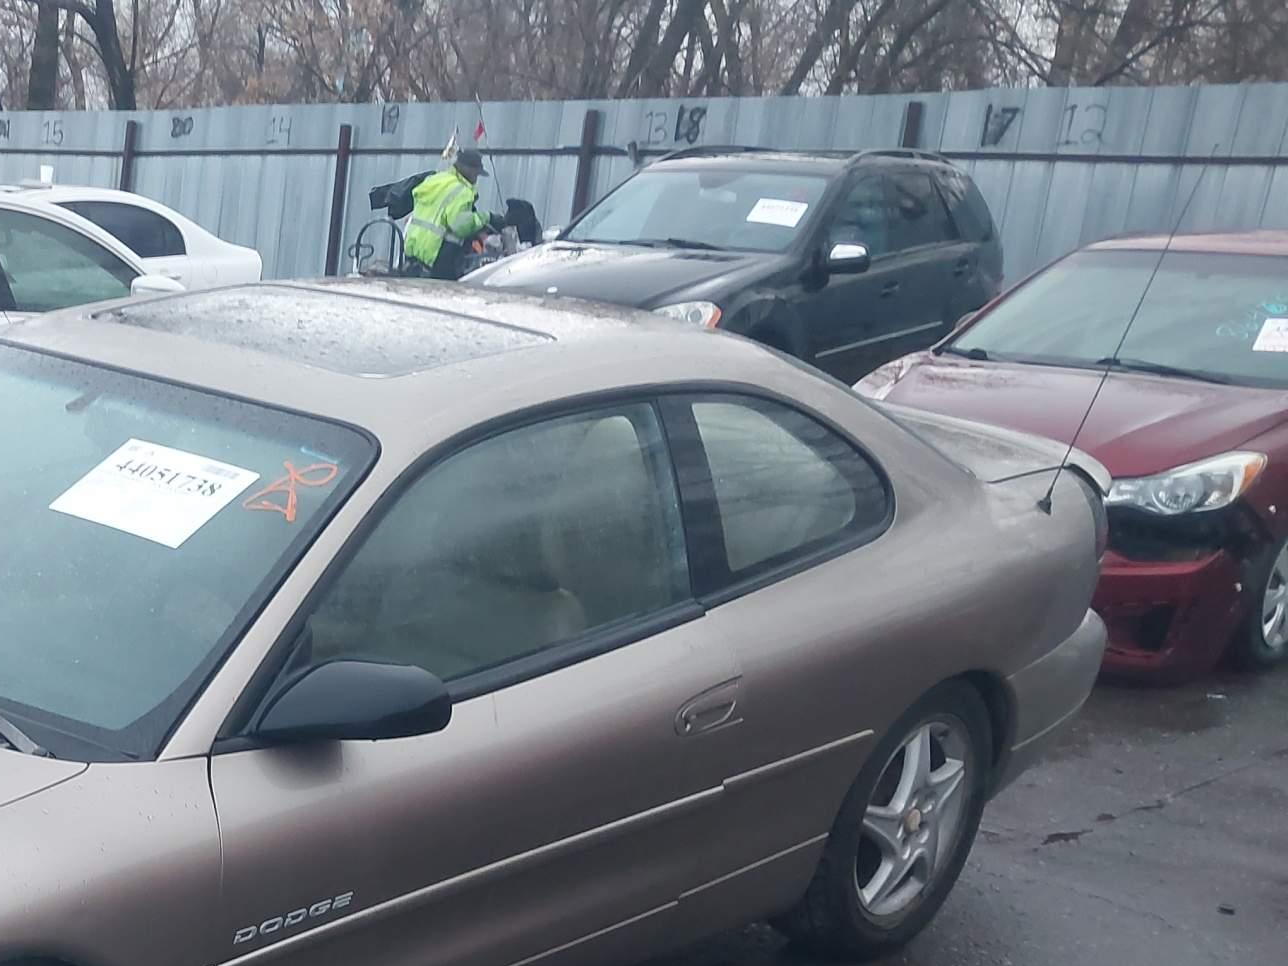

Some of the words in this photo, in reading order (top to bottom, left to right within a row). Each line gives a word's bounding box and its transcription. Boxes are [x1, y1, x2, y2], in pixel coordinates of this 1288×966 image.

[42, 120, 65, 145] 15
[267, 116, 292, 145] 14
[641, 111, 668, 146] 13
[981, 104, 1021, 147] 17
[1057, 104, 1107, 147] 12
[116, 460, 223, 497] 44051738
[232, 891, 355, 945] DODGE
